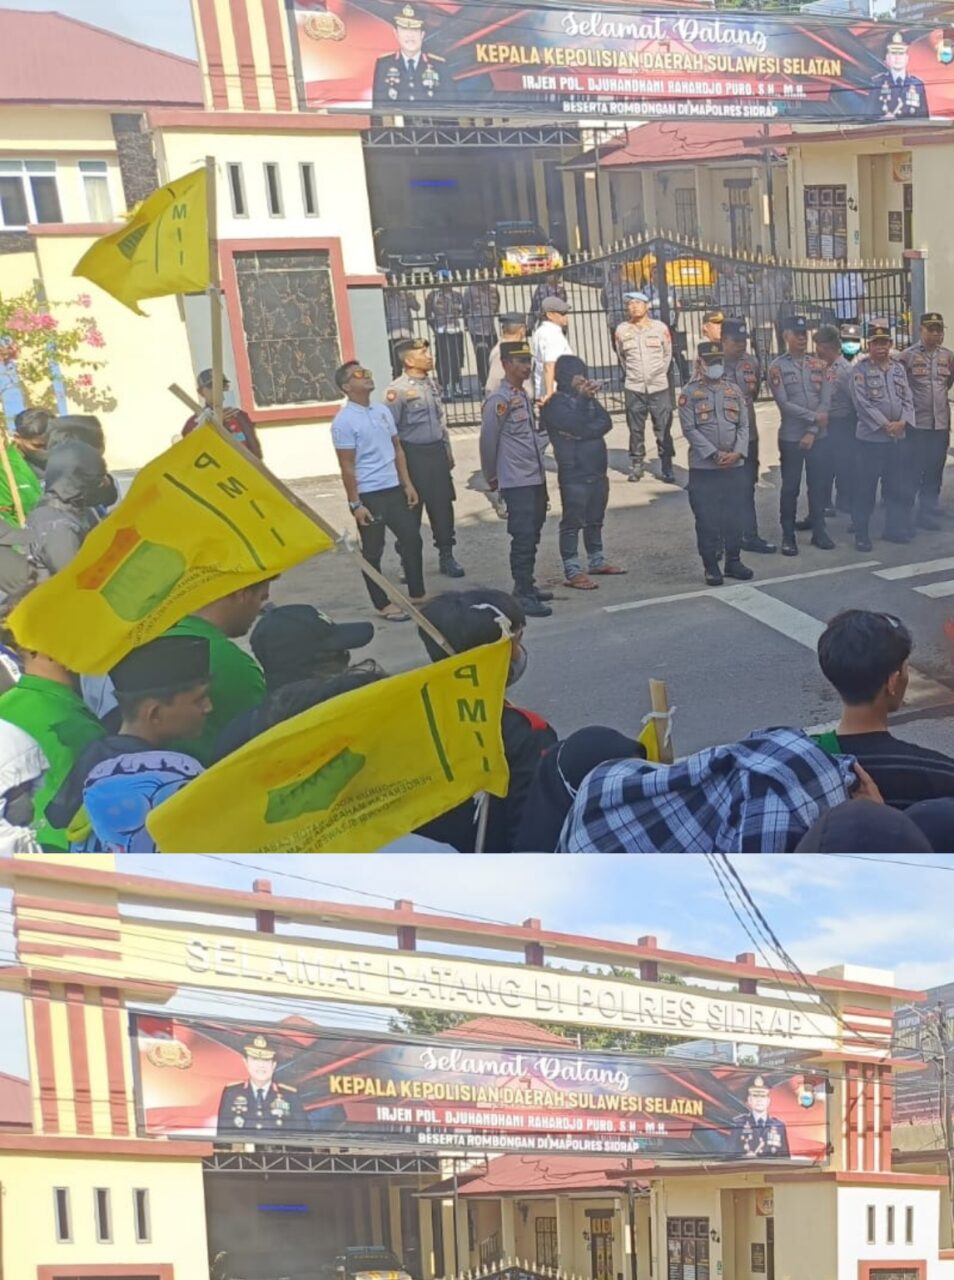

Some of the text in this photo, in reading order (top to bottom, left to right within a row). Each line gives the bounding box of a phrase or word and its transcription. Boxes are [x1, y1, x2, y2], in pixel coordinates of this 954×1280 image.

[561, 12, 769, 52] Selamat Datang
[475, 44, 841, 77] KEPALA KEPOLISIAN DAERAH SULAWESI SELATAN
[522, 74, 557, 90] IRJEN
[563, 100, 778, 118] BESERTA ROMBONGAN DI MAPOLRES SIDRAP
[185, 939, 802, 1039] SELAMAT DATANG DI POLRES SIDRAP
[420, 1047, 632, 1092] Selamat Datang
[329, 1075, 703, 1116] KEPALA KEPOLISIAN DAERAH SULAWESI SELATAN
[377, 1106, 413, 1122] IRJEN
[418, 1132, 640, 1152] BESERTA ROMBONGAN DI MAPOLRES SIDRAP
